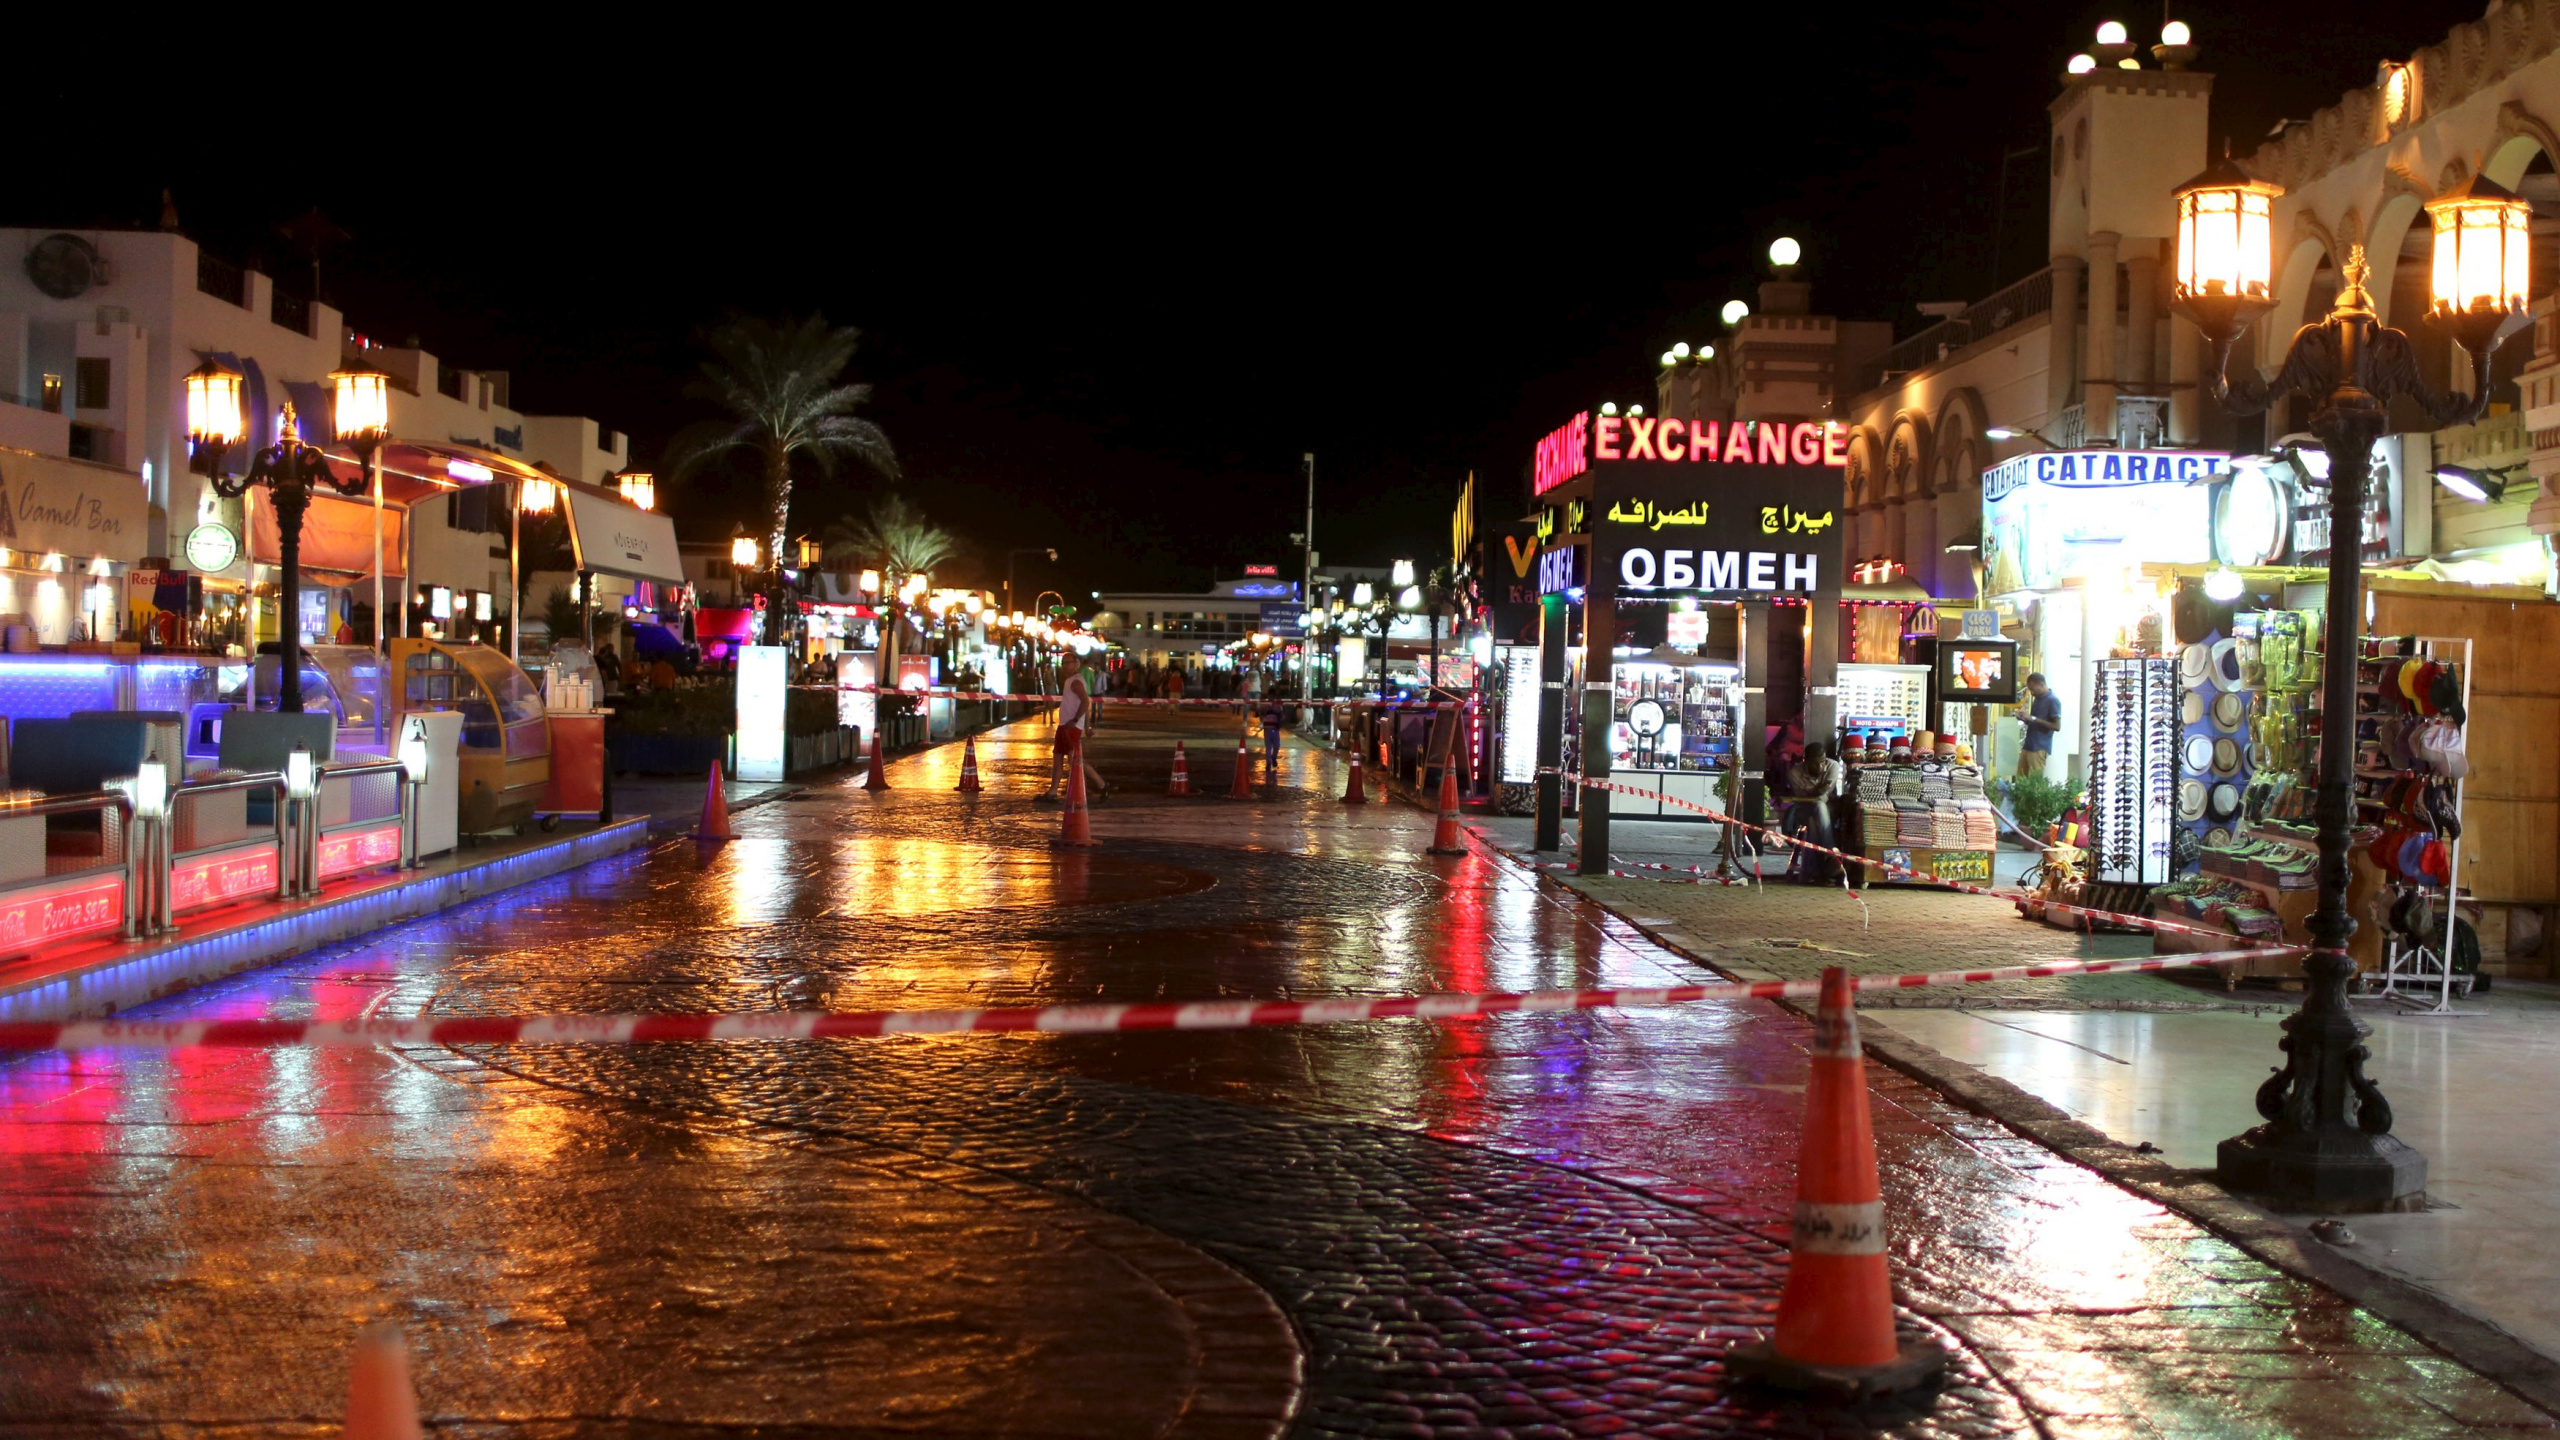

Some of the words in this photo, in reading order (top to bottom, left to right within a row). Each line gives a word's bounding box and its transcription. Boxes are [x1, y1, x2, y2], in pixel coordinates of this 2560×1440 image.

[1534, 411, 1588, 496] EXCHANGE
[1595, 416, 1848, 466] EXCHANGE
[1984, 458, 2028, 497] CATARACT
[2038, 455, 2219, 481] CATARACT
[19, 482, 83, 527] Camel
[87, 499, 122, 534] Bar
[131, 572, 157, 586] Red
[160, 573, 186, 586] Bull
[1540, 545, 1574, 594] ОБМЕН
[1621, 548, 1817, 591] ОБМЕН
[1968, 613, 1993, 626] CLEO
[1968, 625, 1993, 636] PARK
[42, 902, 82, 932] Buona
[83, 898, 109, 922] sera
